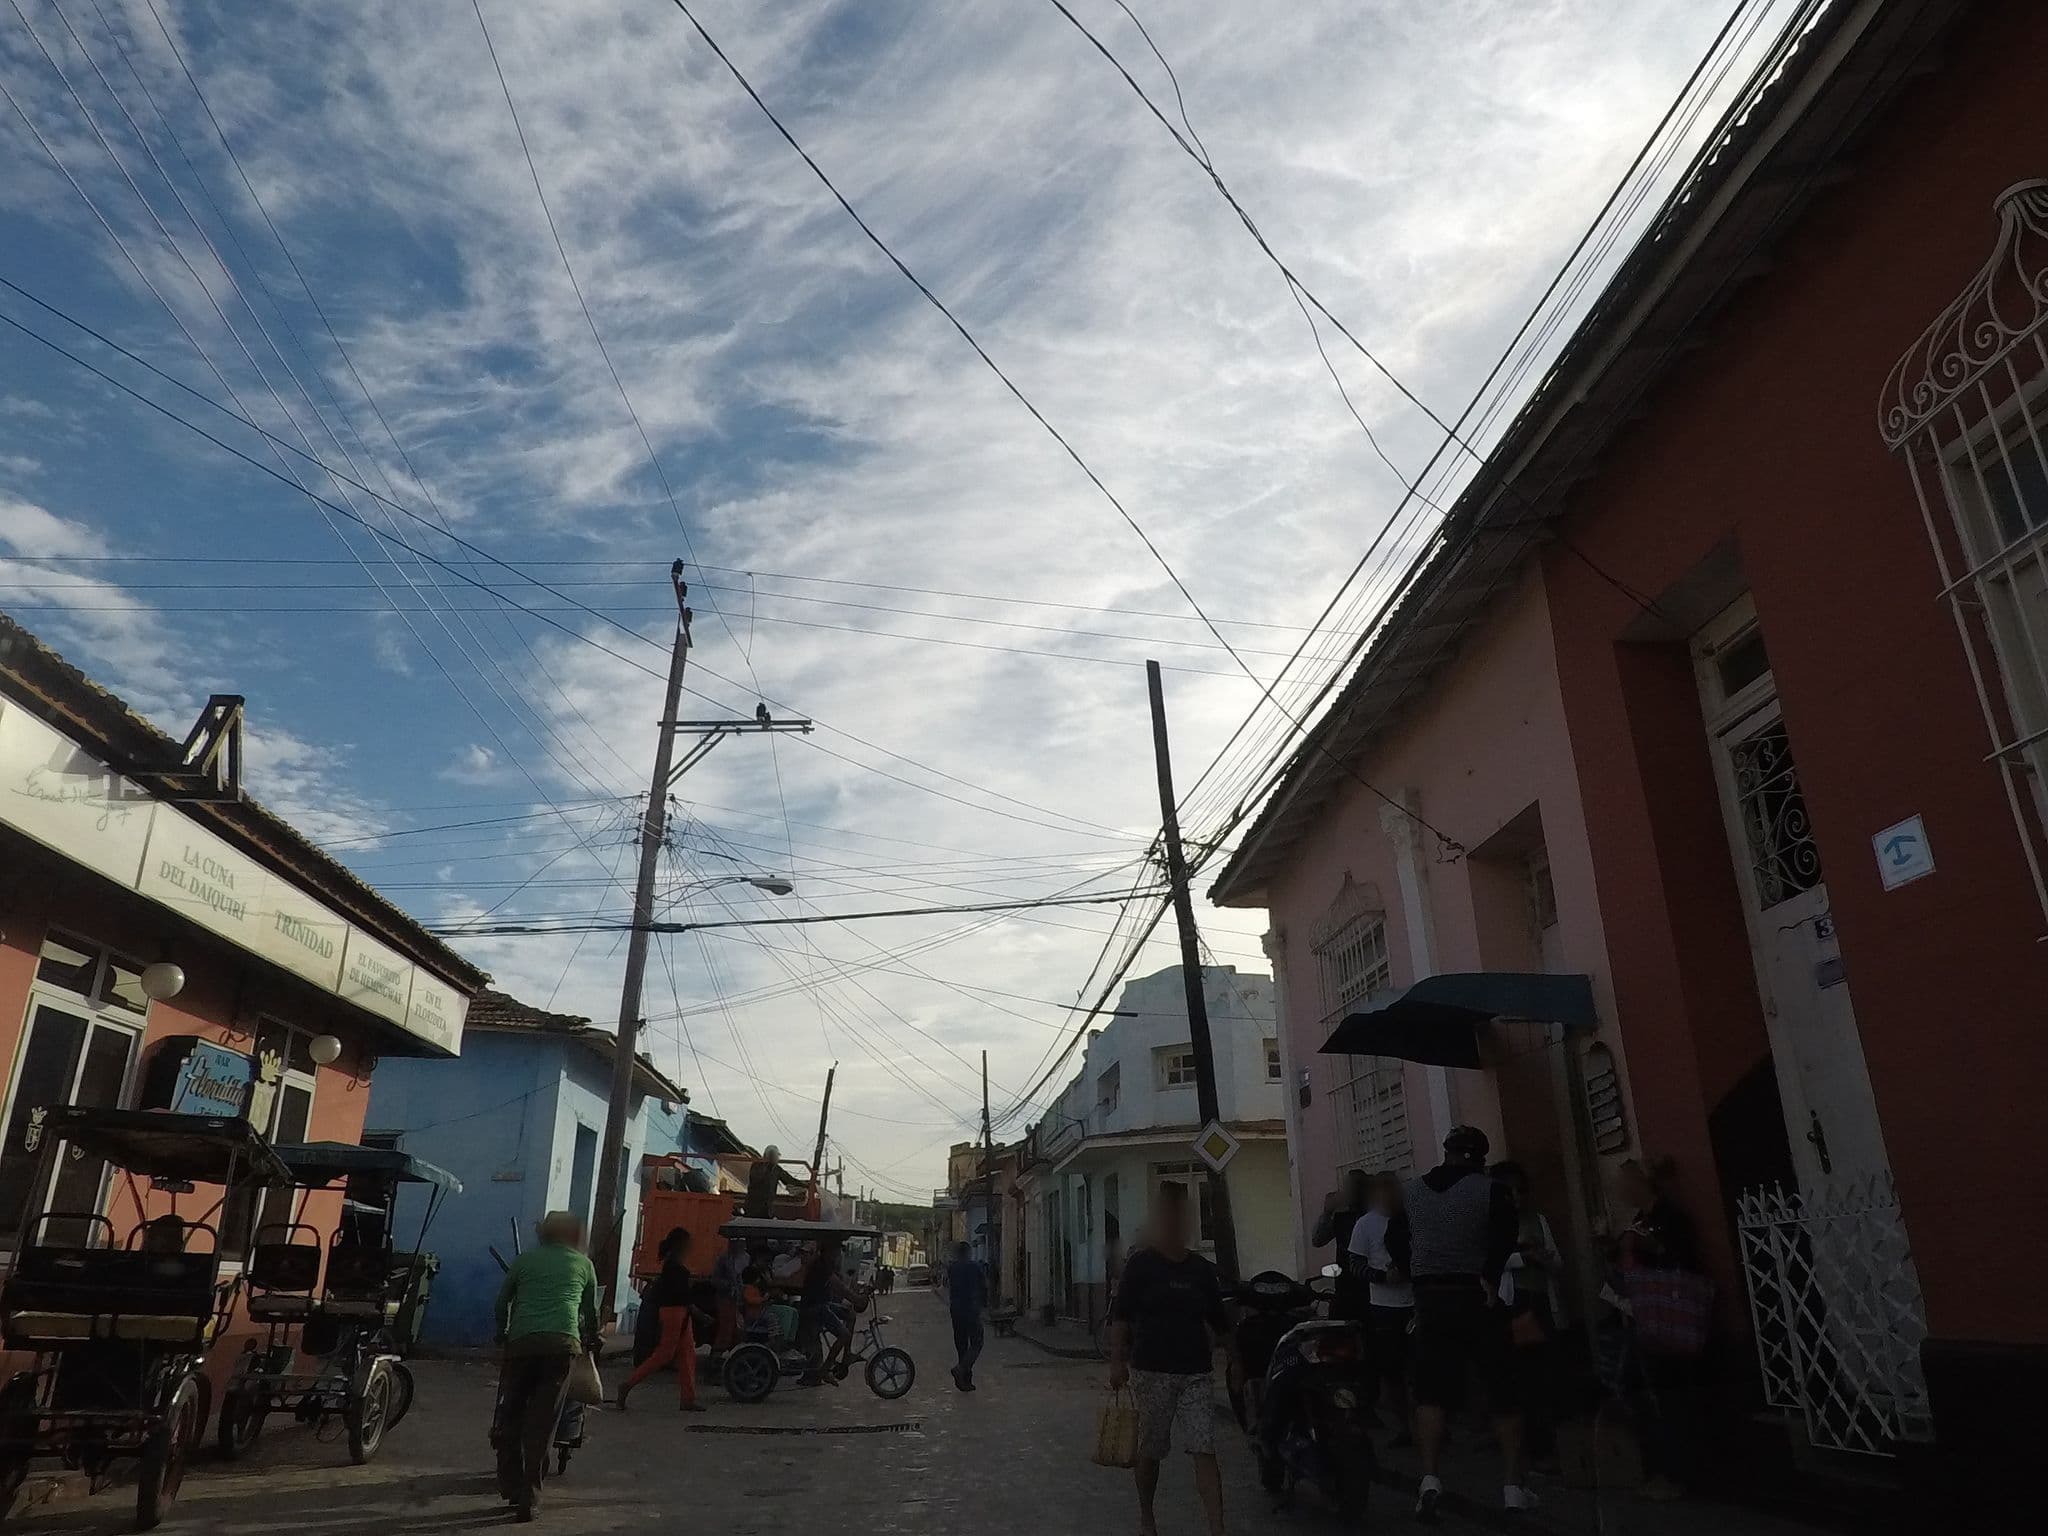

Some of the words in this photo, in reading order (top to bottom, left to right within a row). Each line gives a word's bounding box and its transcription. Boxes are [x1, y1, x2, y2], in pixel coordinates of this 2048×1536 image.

[160, 861, 187, 889] DEL
[183, 845, 200, 869] LA
[202, 857, 235, 891] CUNA
[274, 910, 334, 959] TRINIDAD
[358, 953, 368, 967] EL
[349, 967, 361, 982] DE
[361, 972, 402, 1005] HEMINGWAY
